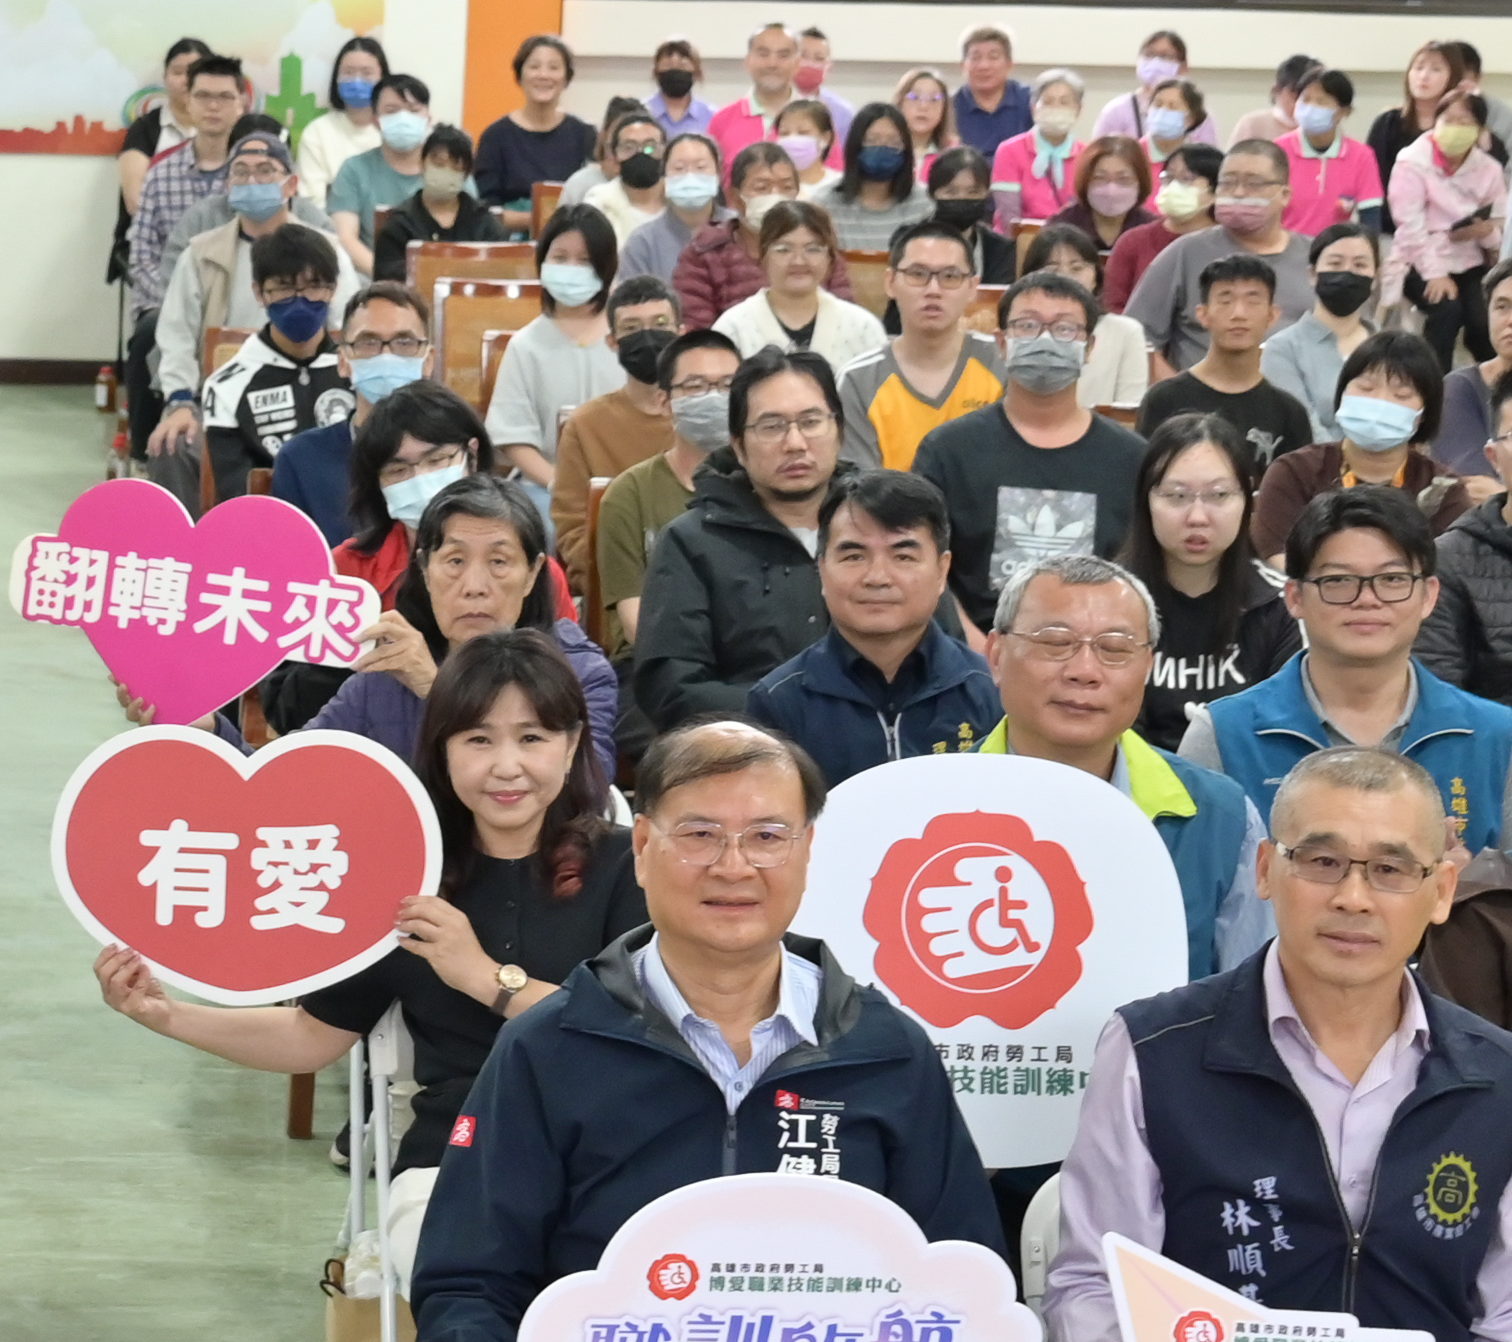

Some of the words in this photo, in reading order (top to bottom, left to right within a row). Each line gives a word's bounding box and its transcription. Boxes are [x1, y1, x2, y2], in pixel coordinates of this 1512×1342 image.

[25, 539, 365, 665] 翻轉未來
[137, 819, 351, 935] 有愛
[820, 1113, 841, 1179] 勞工局
[708, 1274, 902, 1294] 博愛職業技能訓練中心
[709, 1262, 825, 1275] 高雄市政府勞工局
[1235, 1319, 1346, 1339] 高雄市政府勞工局
